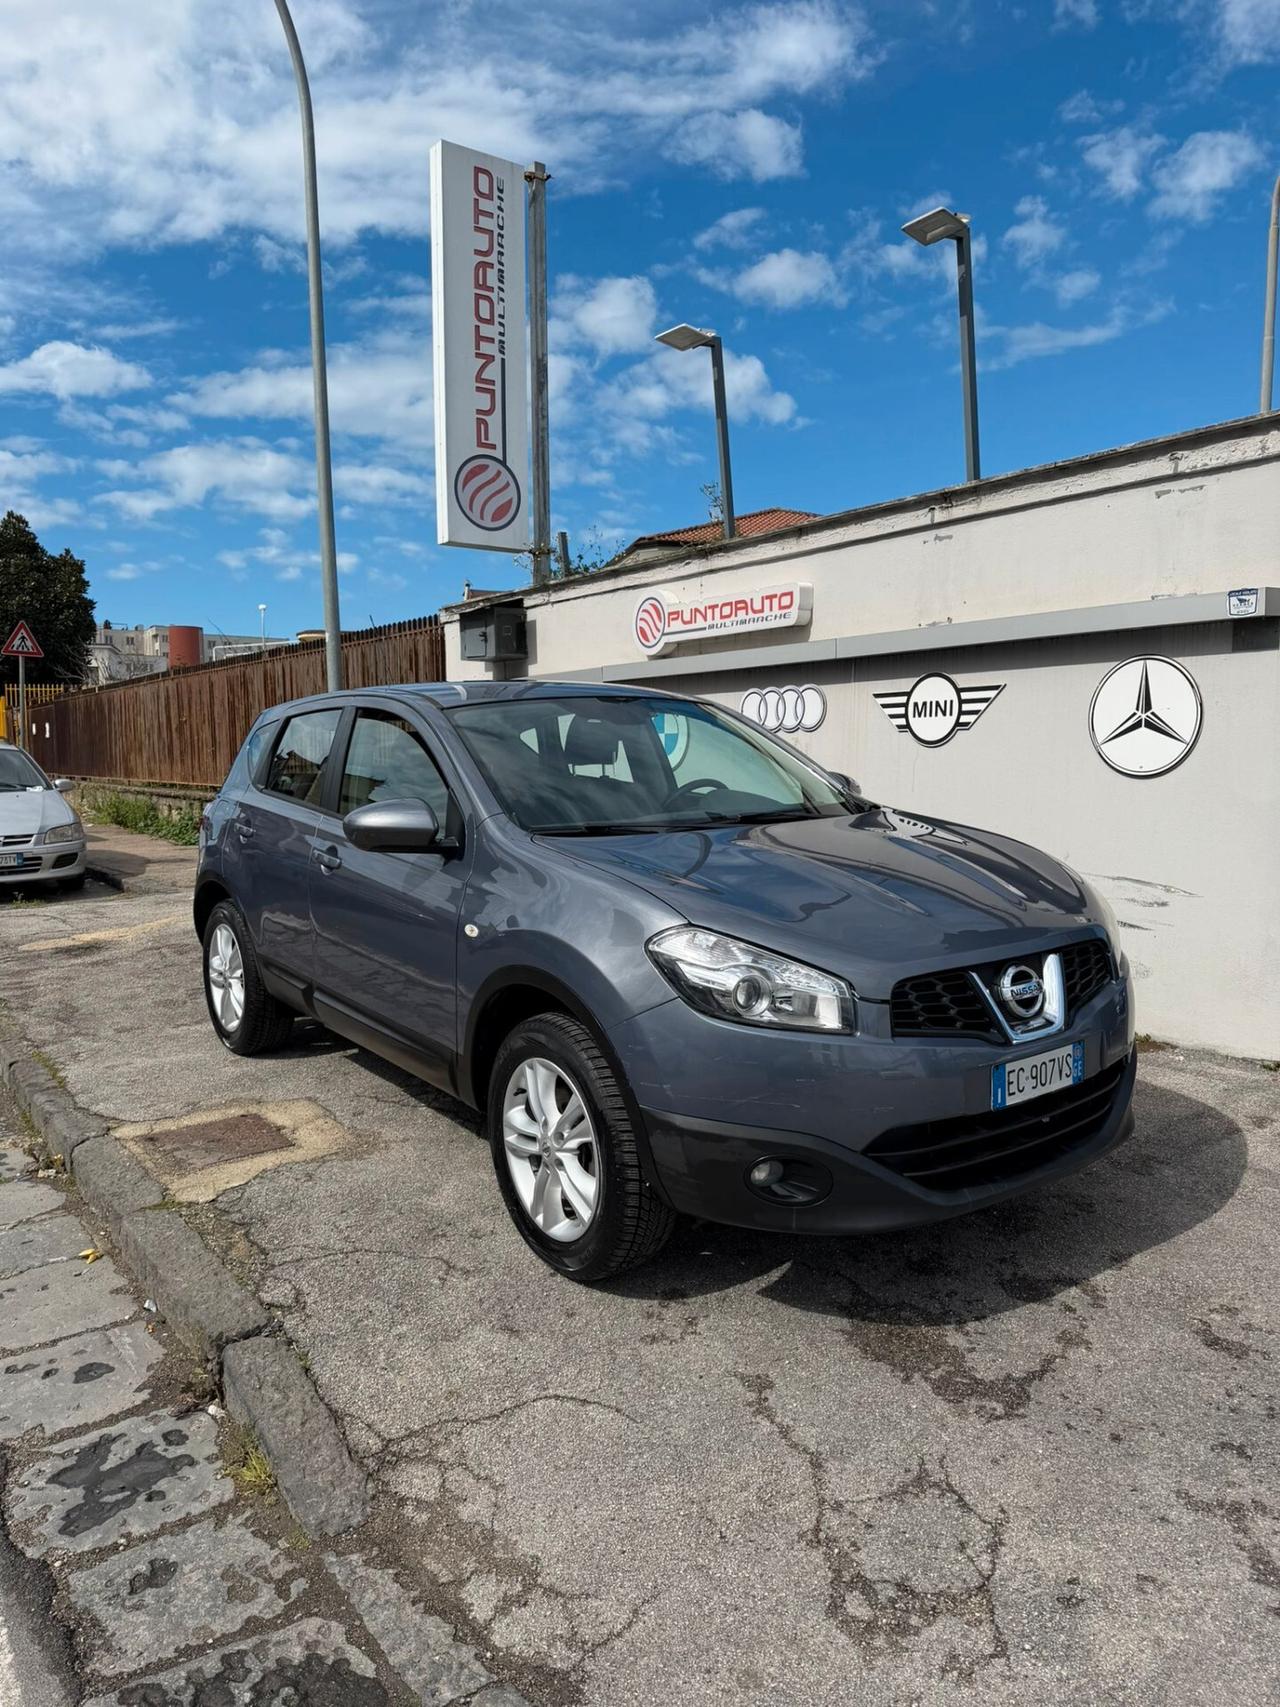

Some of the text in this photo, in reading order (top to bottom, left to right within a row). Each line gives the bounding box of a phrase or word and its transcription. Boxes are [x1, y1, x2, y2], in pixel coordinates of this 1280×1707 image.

[497, 175, 505, 356] MULTIMARCHE
[473, 165, 496, 450] PUNTOAUTO
[667, 591, 794, 628] PUNTOAUTO
[707, 611, 793, 631] MULTIMARCHE
[912, 699, 954, 718] MINI
